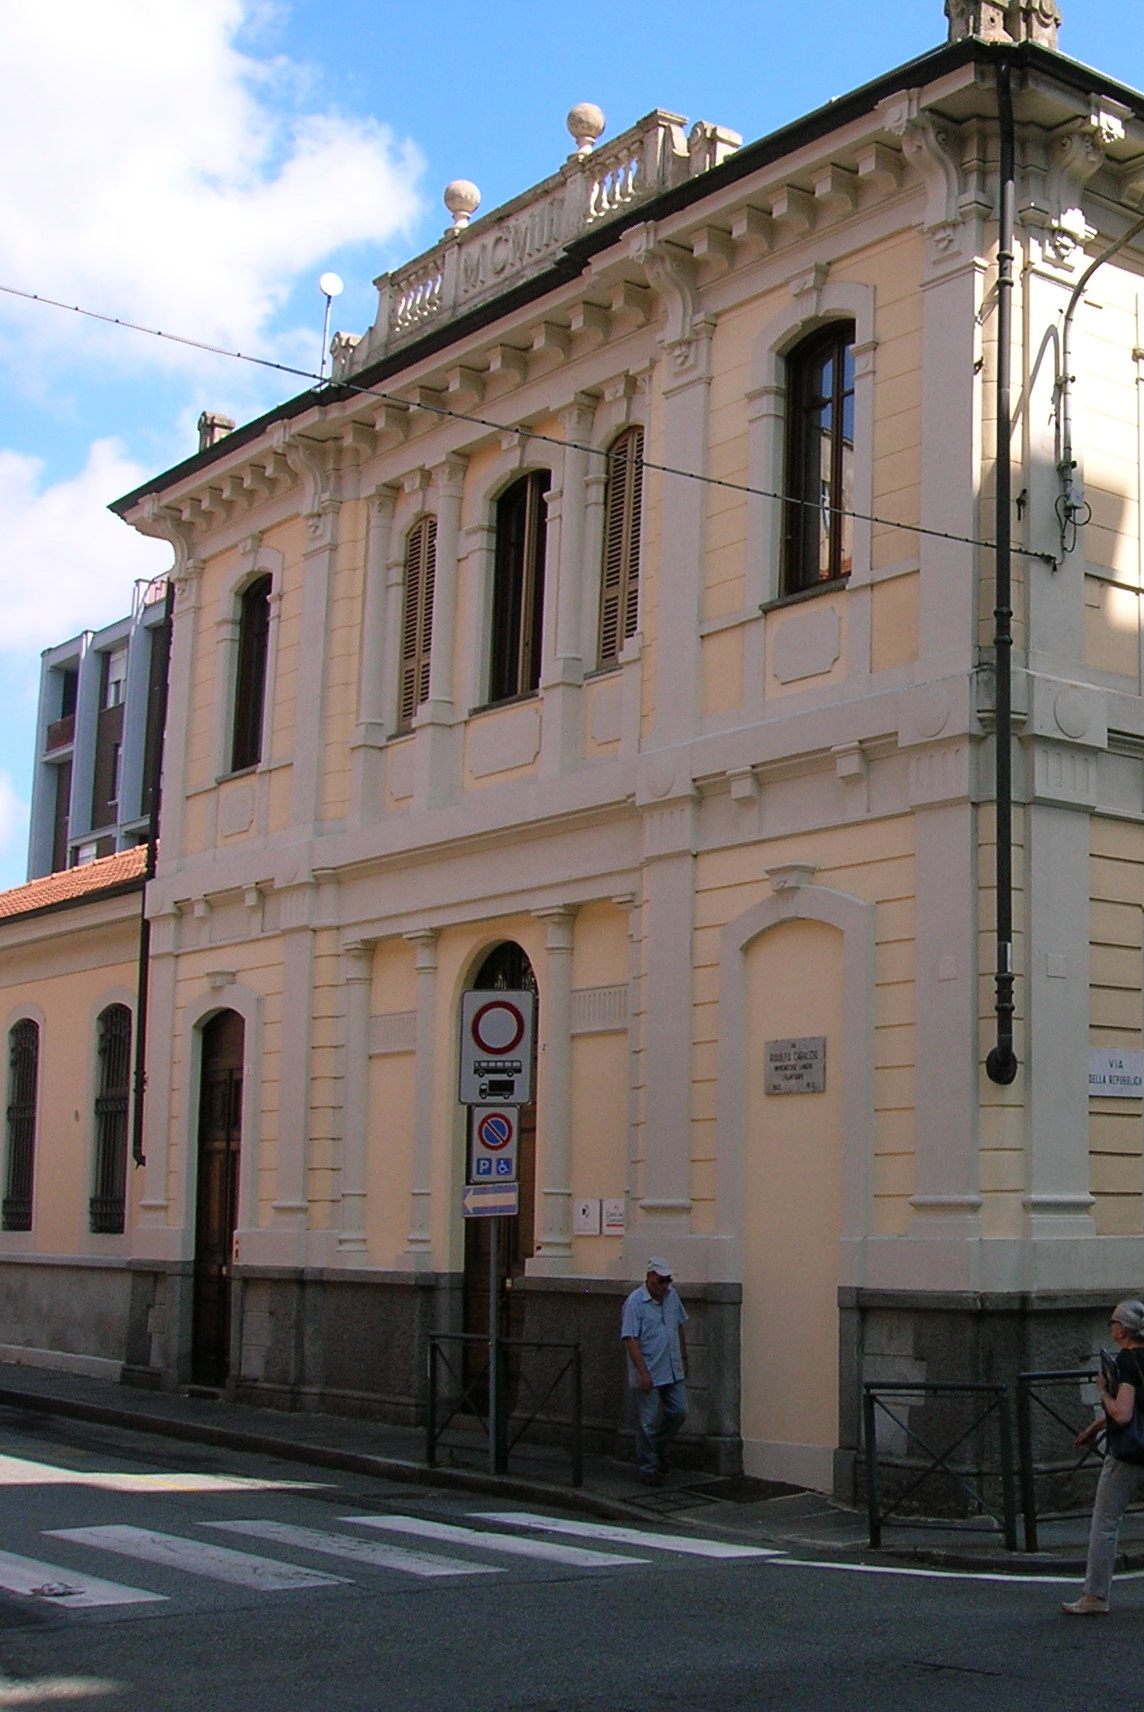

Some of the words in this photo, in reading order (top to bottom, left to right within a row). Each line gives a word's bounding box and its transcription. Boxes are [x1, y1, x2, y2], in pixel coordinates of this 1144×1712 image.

[1108, 1059, 1123, 1069] VIA
[1088, 1073, 1106, 1084] DELLA
[1109, 1074, 1142, 1086] REPUBBLICA
[480, 1159, 489, 1174] P
